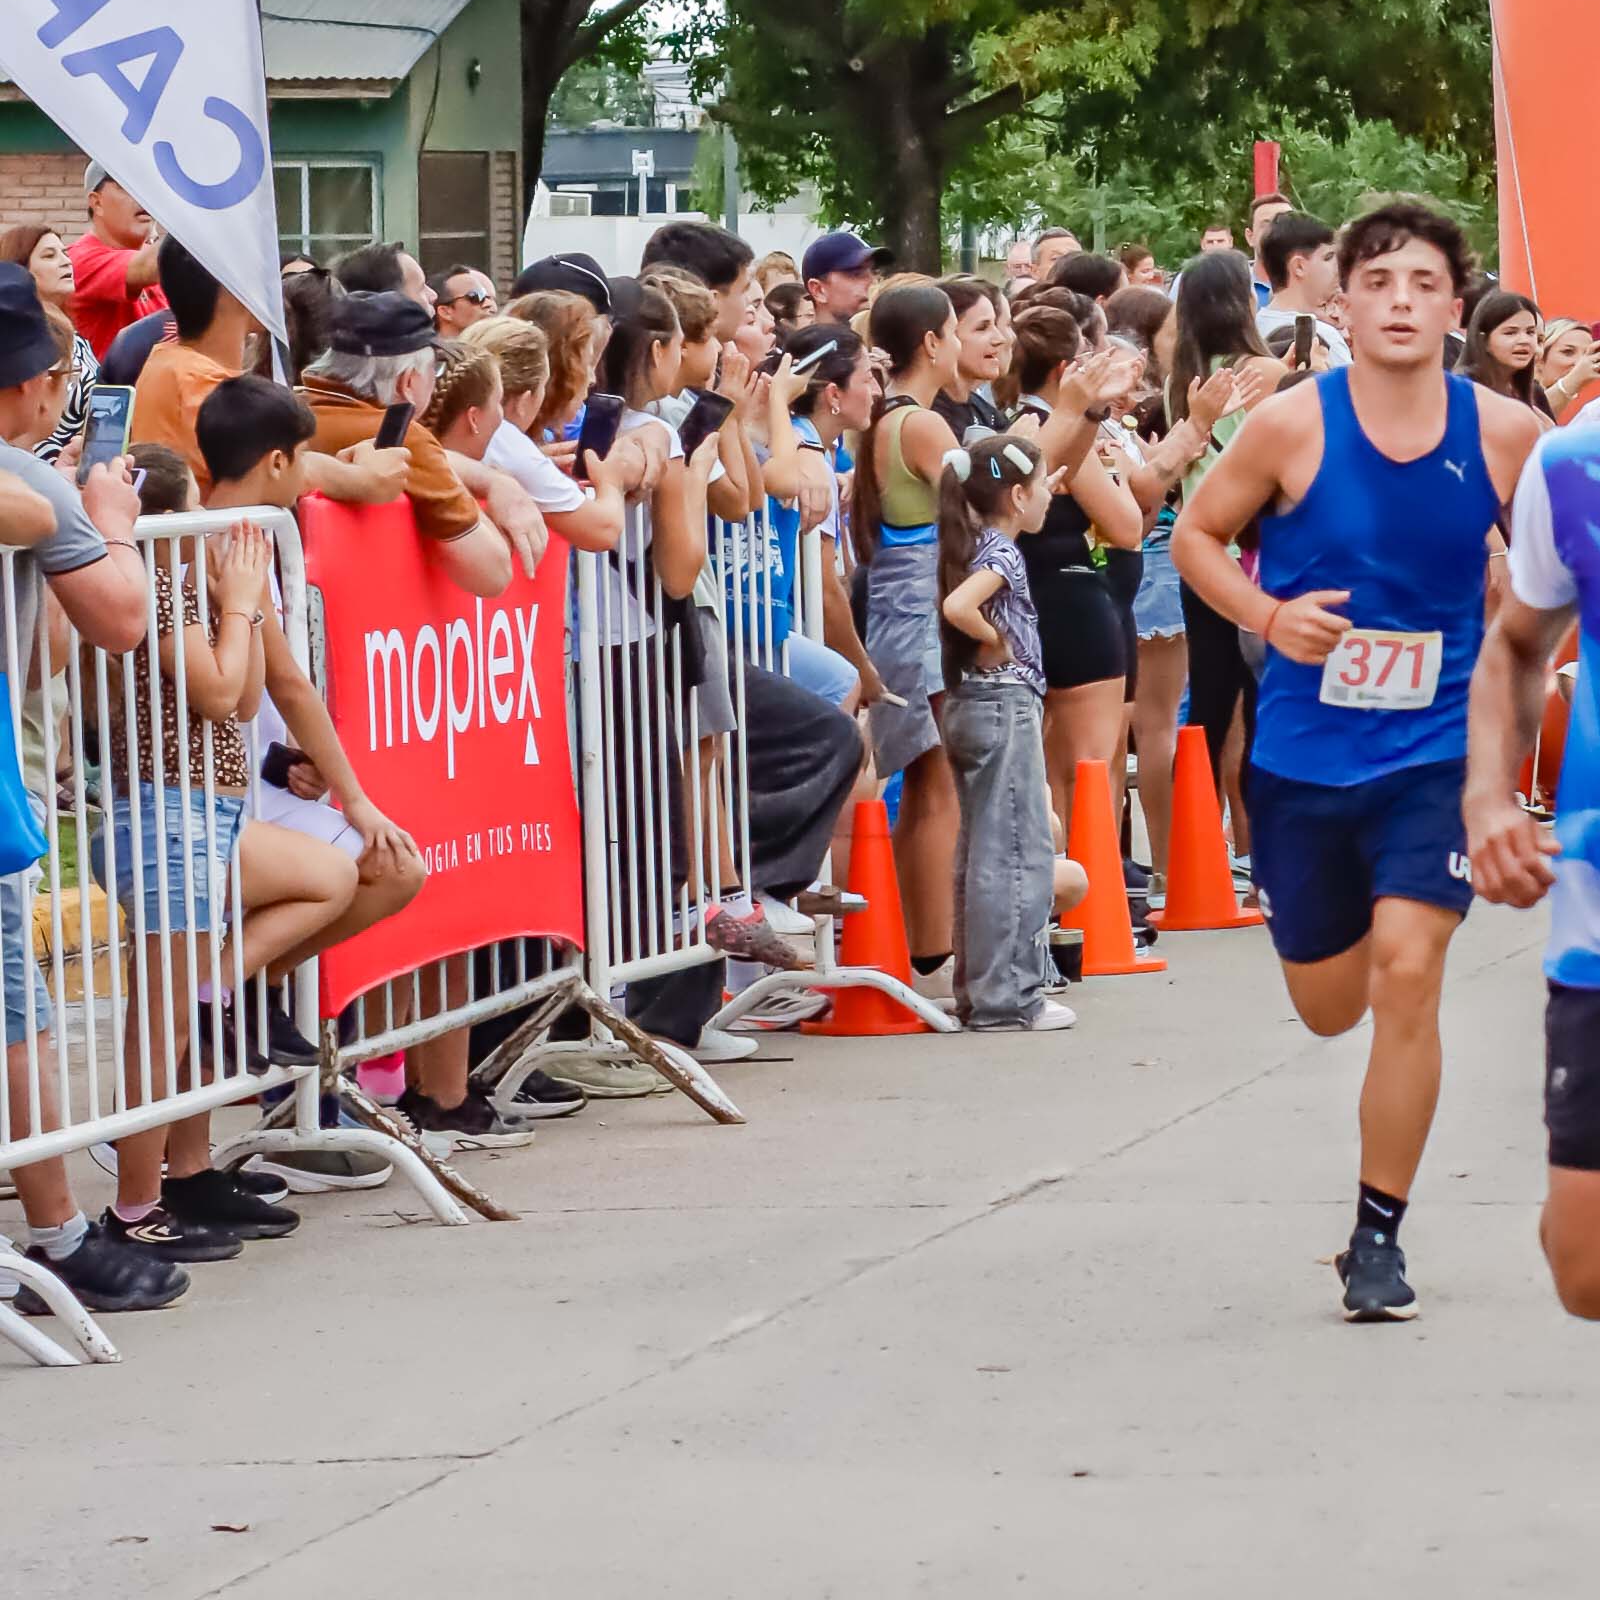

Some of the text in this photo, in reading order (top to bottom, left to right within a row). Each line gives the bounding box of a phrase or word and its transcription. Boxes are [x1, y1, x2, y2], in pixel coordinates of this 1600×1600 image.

[364, 596, 541, 780] moplex
[1339, 637, 1425, 689] 371
[466, 831, 481, 864] EN
[488, 824, 513, 856] TUS
[521, 822, 552, 852] PIES
